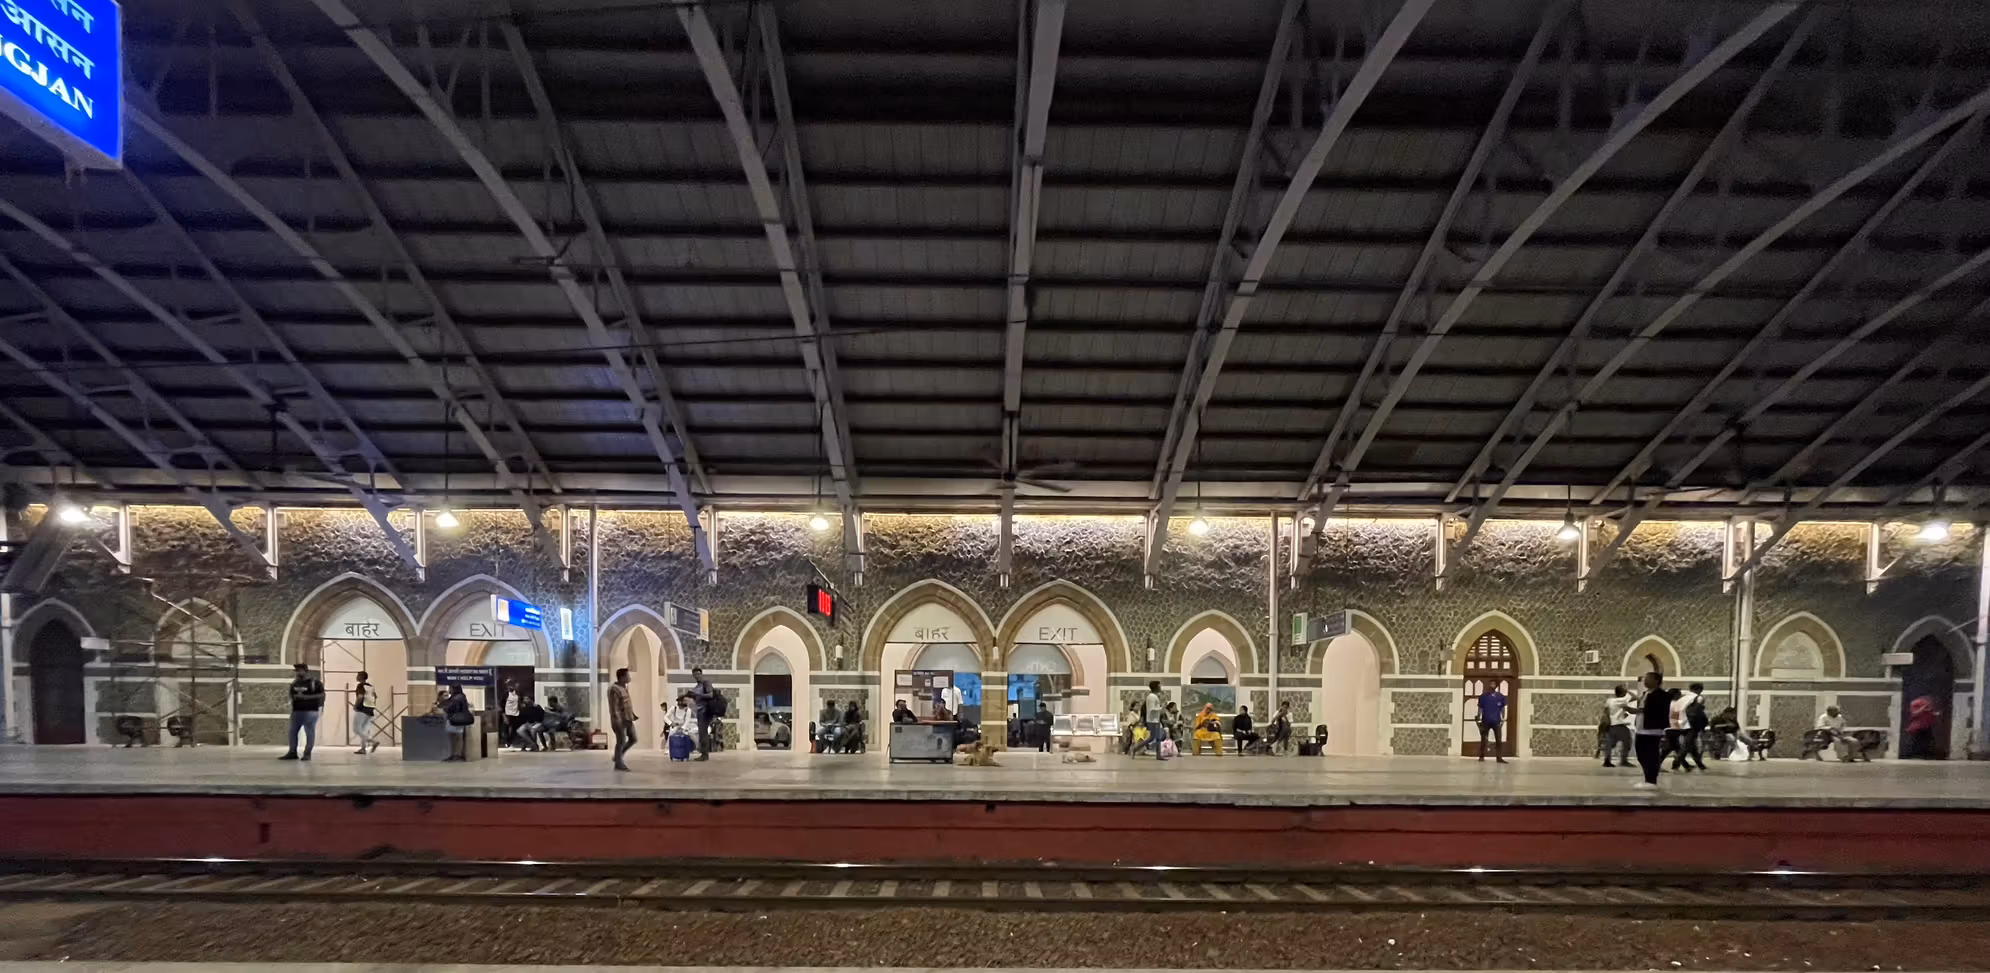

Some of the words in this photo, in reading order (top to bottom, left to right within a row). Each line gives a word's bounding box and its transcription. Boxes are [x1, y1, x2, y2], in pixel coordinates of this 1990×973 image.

[0, 34, 94, 119] GJAN
[469, 622, 508, 638] EXIT
[1039, 626, 1078, 641] EXIT
